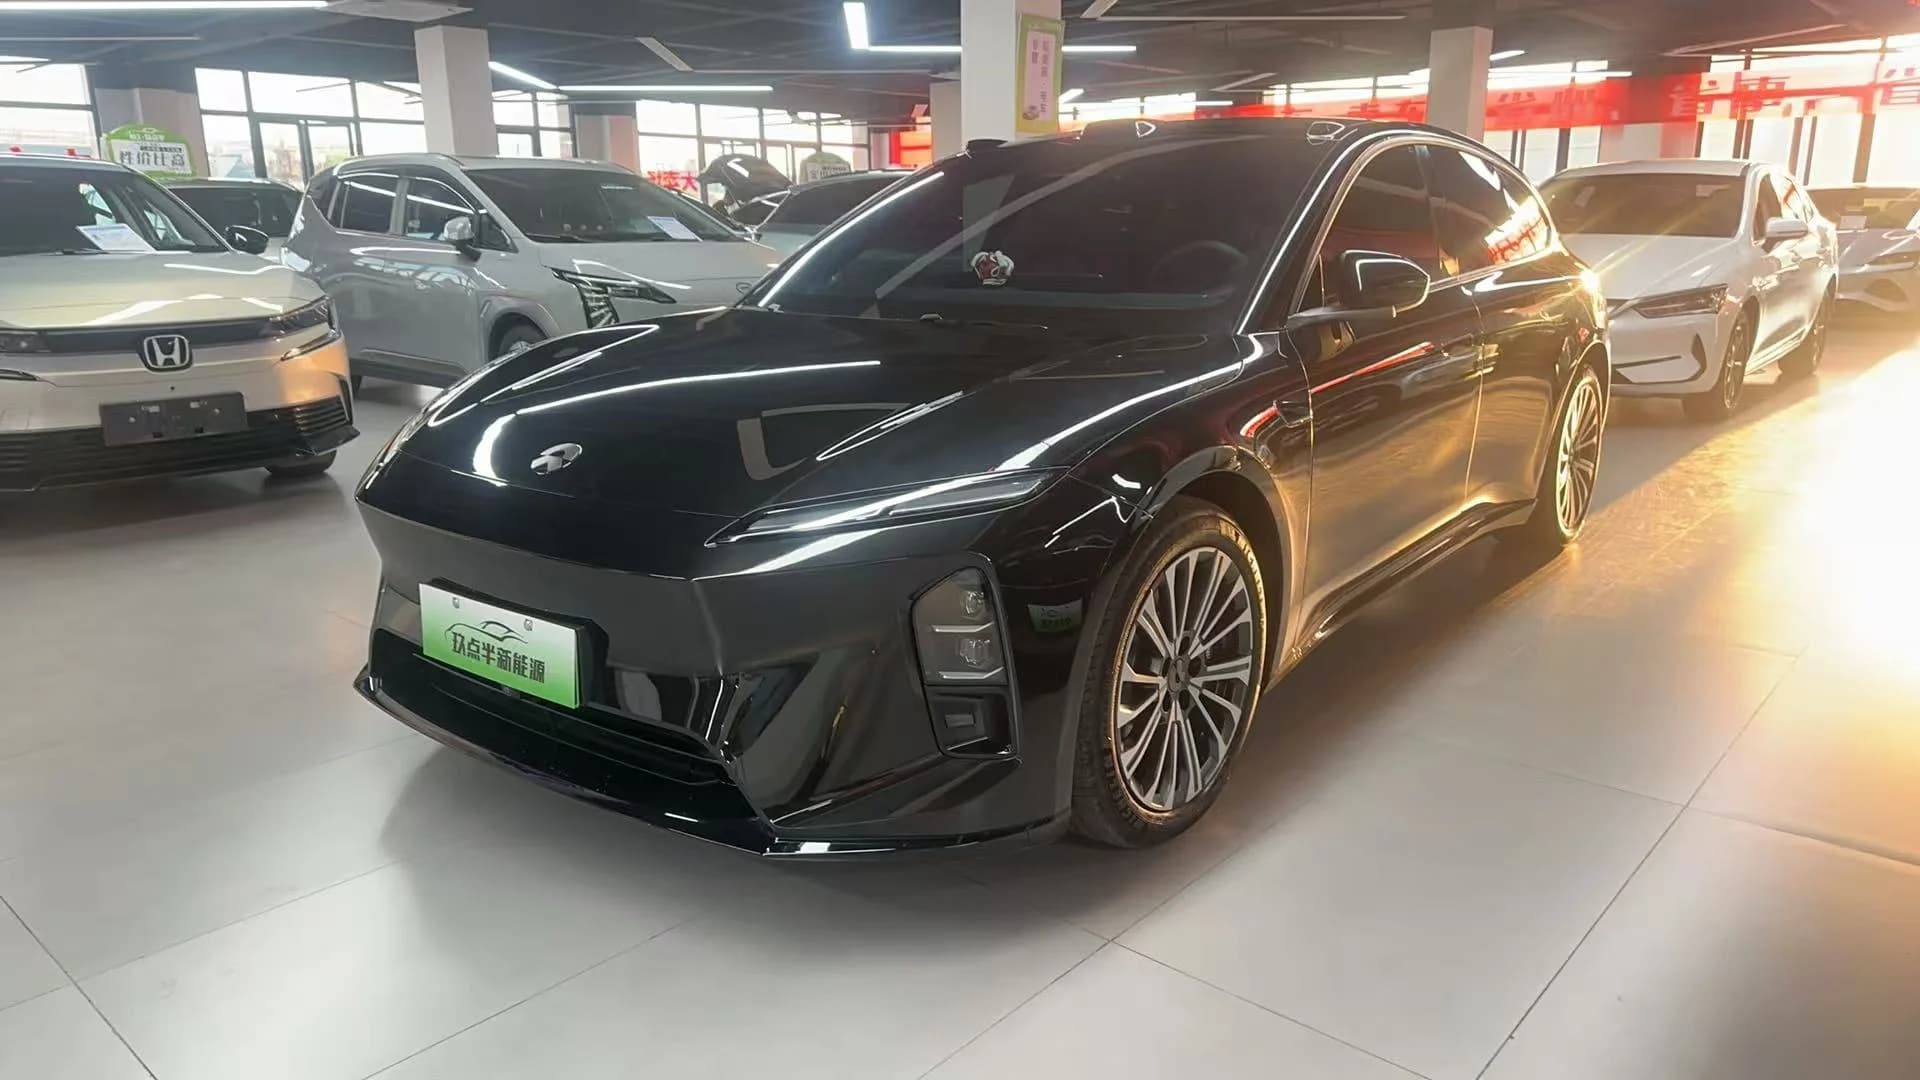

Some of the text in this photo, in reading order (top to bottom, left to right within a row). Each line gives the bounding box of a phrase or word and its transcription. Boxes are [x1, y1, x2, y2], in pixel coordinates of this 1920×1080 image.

[451, 631, 545, 684] 玖点半新能源
